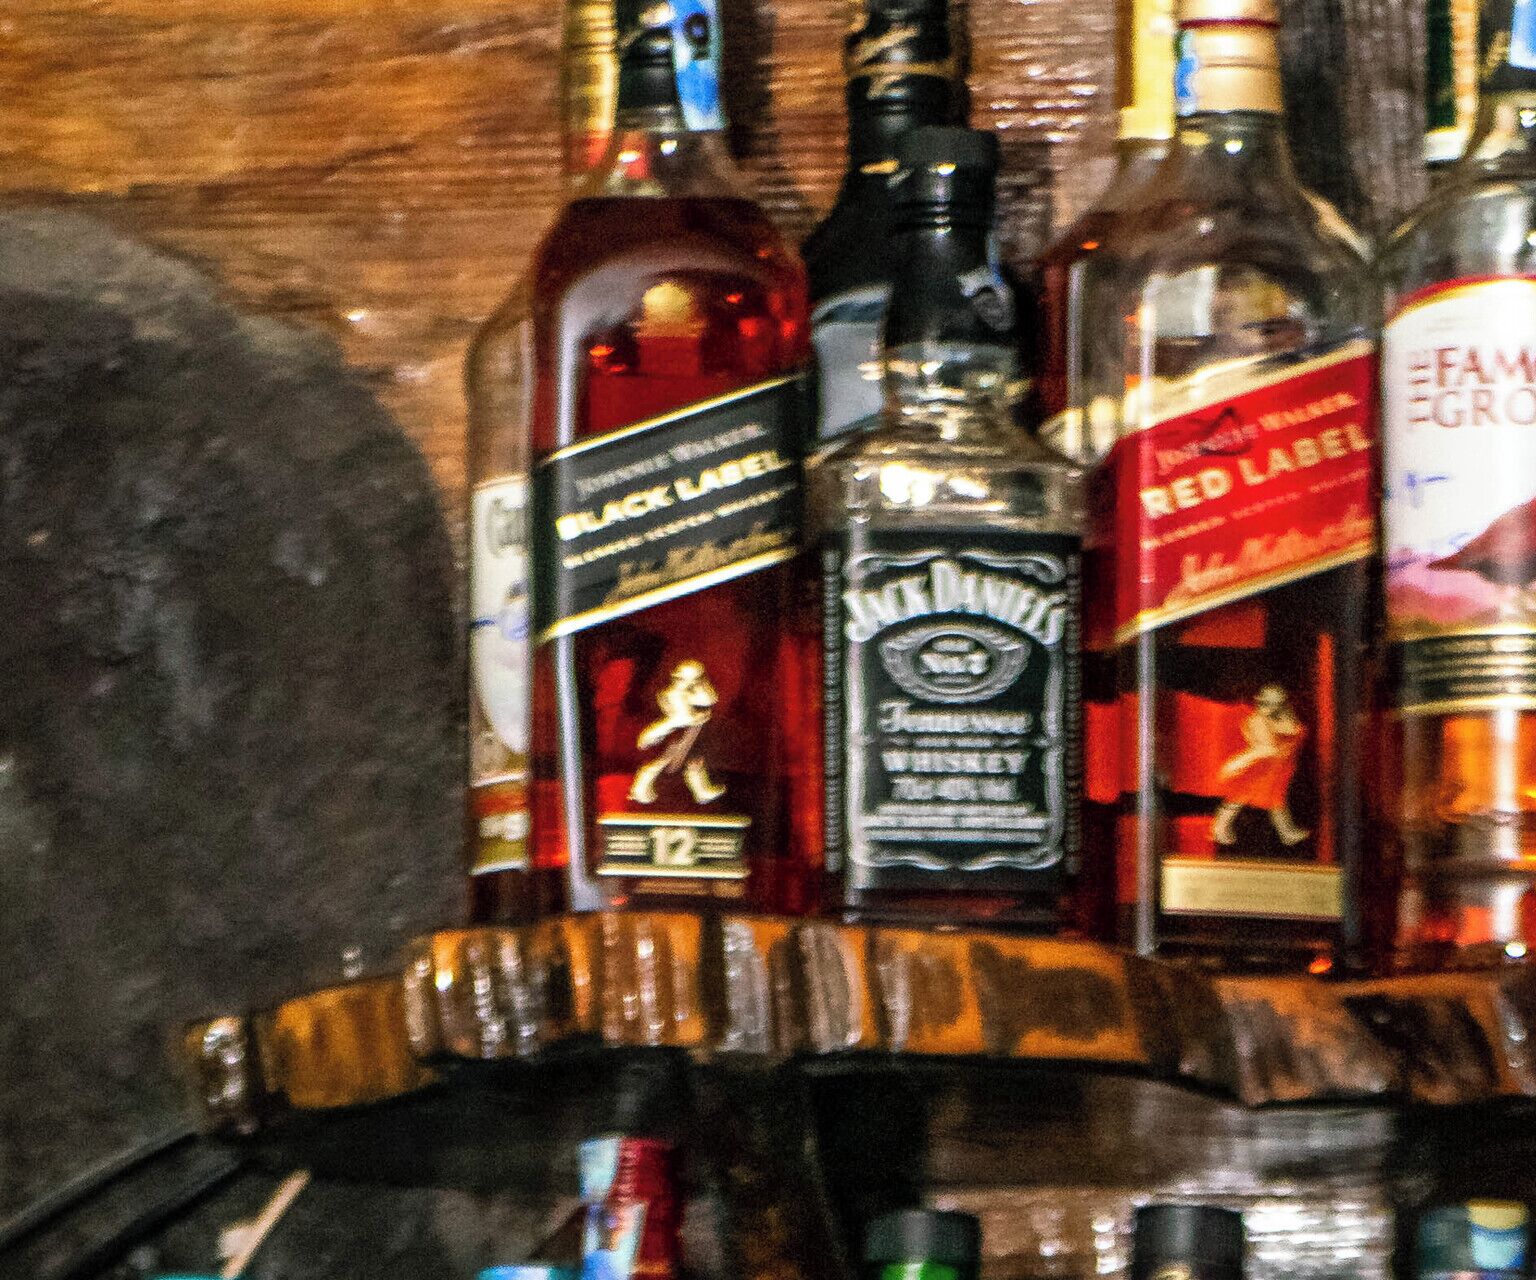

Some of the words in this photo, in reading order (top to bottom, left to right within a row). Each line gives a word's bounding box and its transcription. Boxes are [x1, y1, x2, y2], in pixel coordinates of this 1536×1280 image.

[555, 485, 677, 541] BLACK
[673, 450, 793, 502] LABEL
[1139, 467, 1234, 519] RED
[1238, 423, 1372, 486] LABEL
[842, 574, 934, 643] JACK
[650, 827, 696, 866] 12
